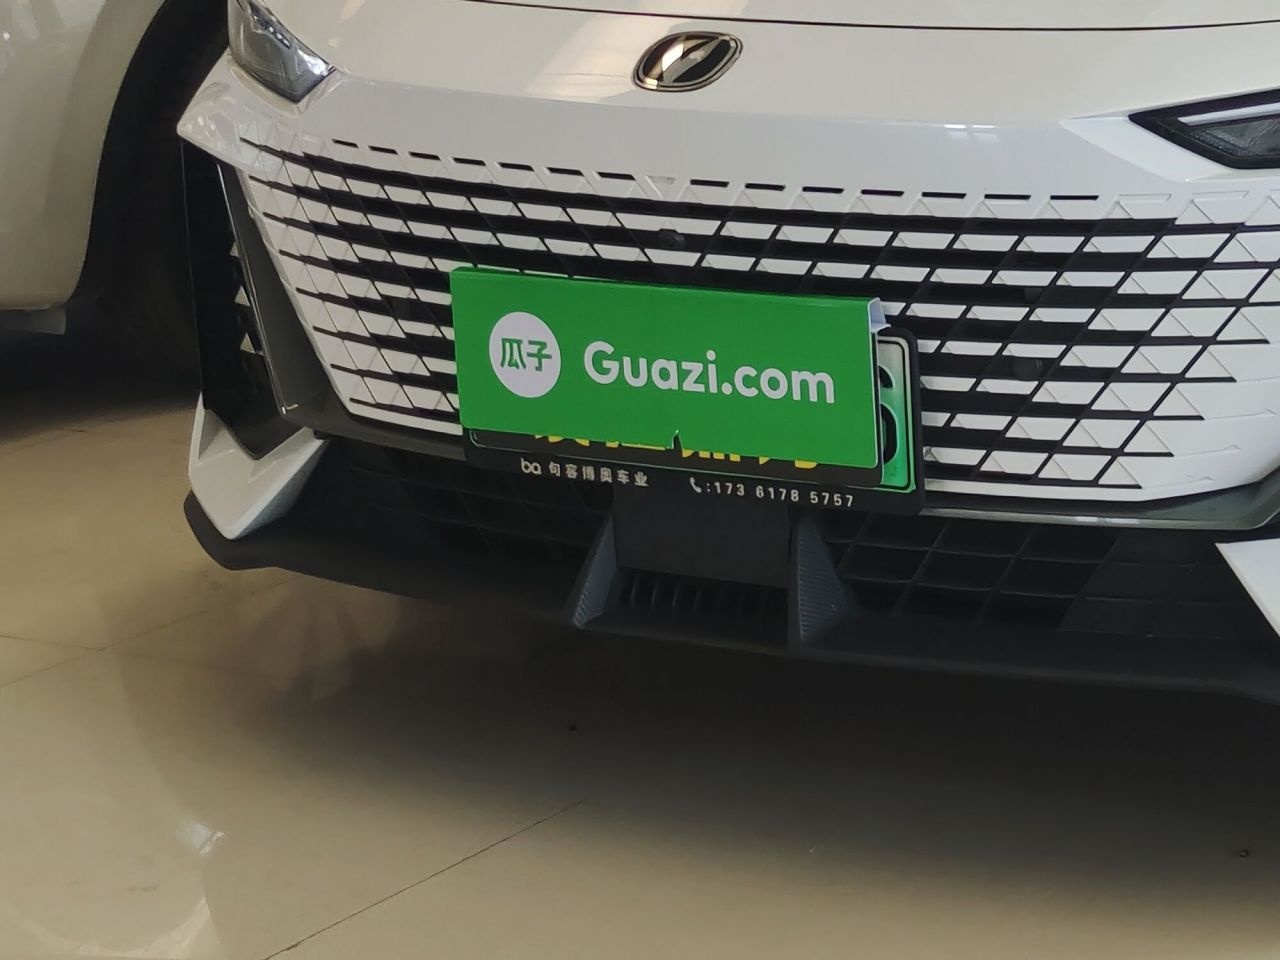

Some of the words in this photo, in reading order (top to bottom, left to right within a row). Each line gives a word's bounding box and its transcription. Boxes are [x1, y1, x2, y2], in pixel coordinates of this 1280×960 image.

[500, 337, 552, 372] 瓜子
[584, 340, 835, 404] Guazi.com
[755, 485, 799, 502] 6178
[810, 491, 853, 507] 5757
